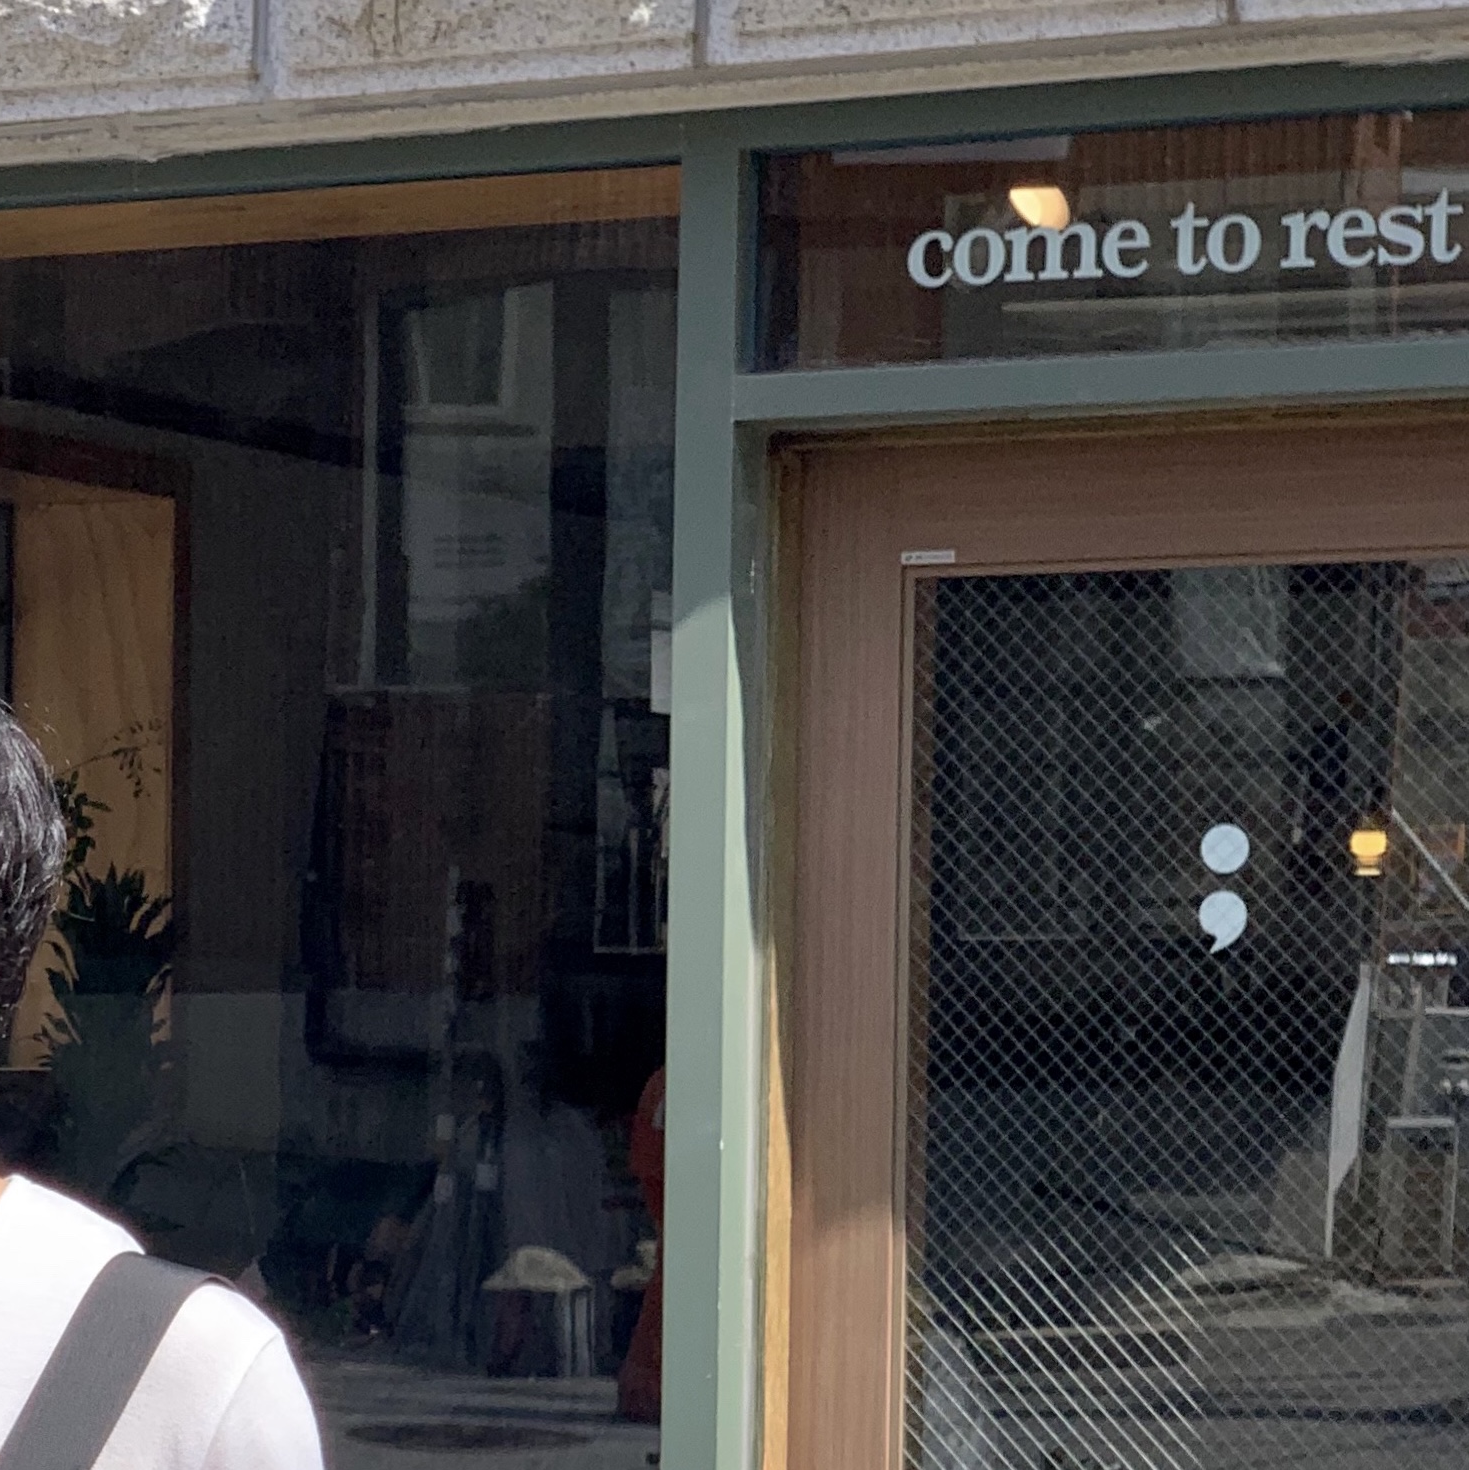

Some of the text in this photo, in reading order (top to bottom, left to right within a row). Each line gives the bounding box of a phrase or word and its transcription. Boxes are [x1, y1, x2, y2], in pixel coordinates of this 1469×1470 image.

[906, 187, 1464, 288] come to rest
